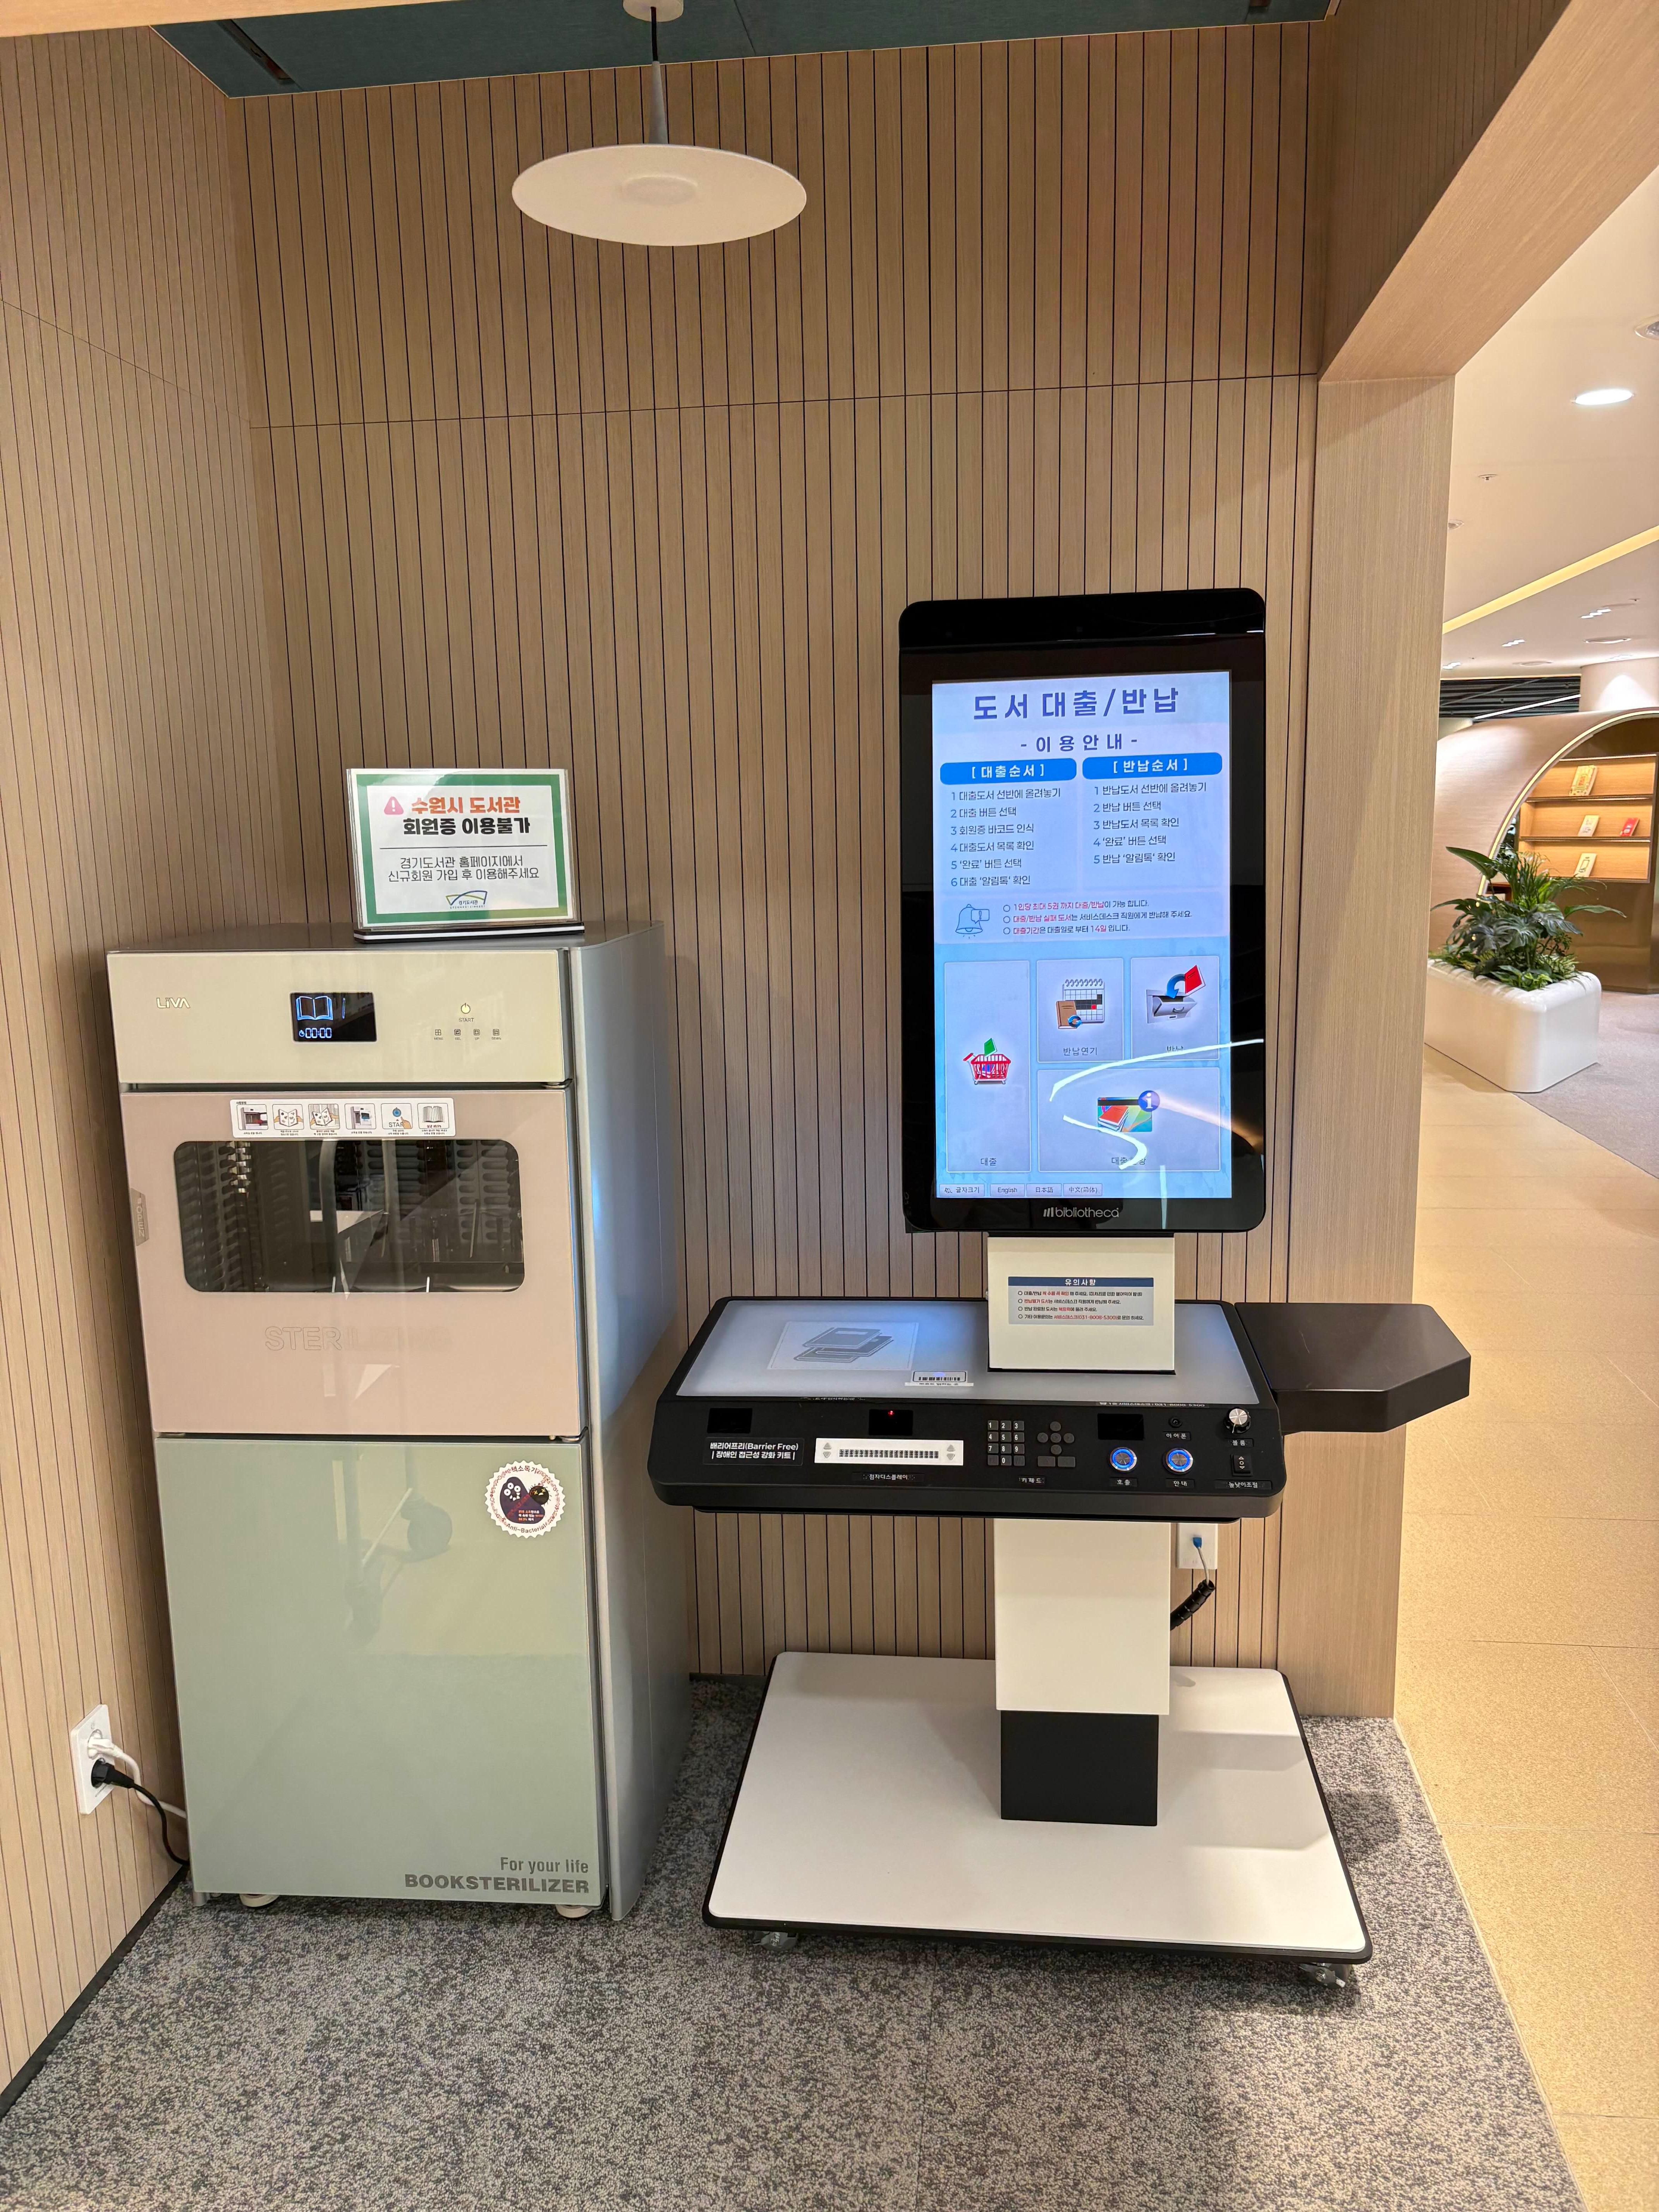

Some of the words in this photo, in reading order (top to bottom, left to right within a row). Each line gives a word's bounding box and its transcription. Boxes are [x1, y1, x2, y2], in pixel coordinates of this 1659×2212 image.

[974, 694, 1027, 720] 도서
[1042, 688, 1178, 717] 대출/반납
[1036, 733, 1122, 753] 이용안내
[981, 764, 1035, 778] 대출순서
[1123, 759, 1178, 773] 반납순서
[951, 792, 955, 800] 1
[959, 790, 994, 800] 대출도서
[997, 789, 1023, 800] 선반에
[1025, 788, 1061, 799] 올려놓기
[1094, 787, 1098, 795] 1
[1103, 785, 1138, 795] 반납도서
[1141, 783, 1168, 794] 선반에
[1171, 782, 1206, 793] 올려놓기
[412, 797, 464, 814] 수원시
[469, 796, 520, 814] 도서관
[1094, 804, 1100, 812] 2
[1103, 802, 1120, 812] 반납
[1123, 802, 1140, 811] 버튼
[1143, 801, 1161, 811] 선택
[951, 810, 957, 818] 2
[959, 808, 977, 818] 대출
[979, 807, 996, 817] 버튼
[999, 807, 1016, 817] 선택
[403, 818, 456, 835] 회원증
[462, 817, 530, 835] 이용불가
[951, 827, 957, 835] 3
[959, 825, 985, 835] 회원증
[988, 824, 1014, 834] 바코드
[1017, 823, 1034, 833] 인식
[1094, 821, 1100, 830] 3
[1103, 819, 1138, 830] 반납도서
[1141, 818, 1158, 828] 목록
[1161, 817, 1179, 827] 확인
[951, 844, 958, 852] 4
[960, 842, 994, 852] 대출도서
[997, 842, 1014, 851] 목록
[1017, 841, 1034, 850] 확인
[1093, 838, 1101, 847] 4
[1128, 836, 1146, 846] 버튼
[1148, 835, 1166, 845] 선택
[400, 857, 455, 869] 경기도서관
[459, 855, 523, 868] 홈페이지에서
[951, 861, 957, 869] 5
[985, 859, 1002, 869] 버튼
[1004, 859, 1021, 868] 선택
[1094, 855, 1100, 864] 5
[1103, 854, 1120, 864] 반납
[1158, 852, 1175, 862] 확인
[388, 870, 432, 882] 신규회원
[436, 869, 457, 881] 가입
[461, 869, 472, 880] 후
[476, 868, 539, 880] 이용해주세요
[951, 878, 957, 886] 6
[960, 877, 977, 886] 대출
[1013, 875, 1030, 885] 확인
[1013, 915, 1042, 923] 대출/반납
[1063, 1047, 1097, 1056] 반납연기
[980, 1157, 997, 1166] 대출
[1056, 1207, 1119, 1218] bibliotheca
[500, 1857, 524, 1871] For
[528, 1860, 560, 1874] your
[566, 1859, 589, 1874] life
[405, 1874, 589, 1894] BOOKSTERILIZER
